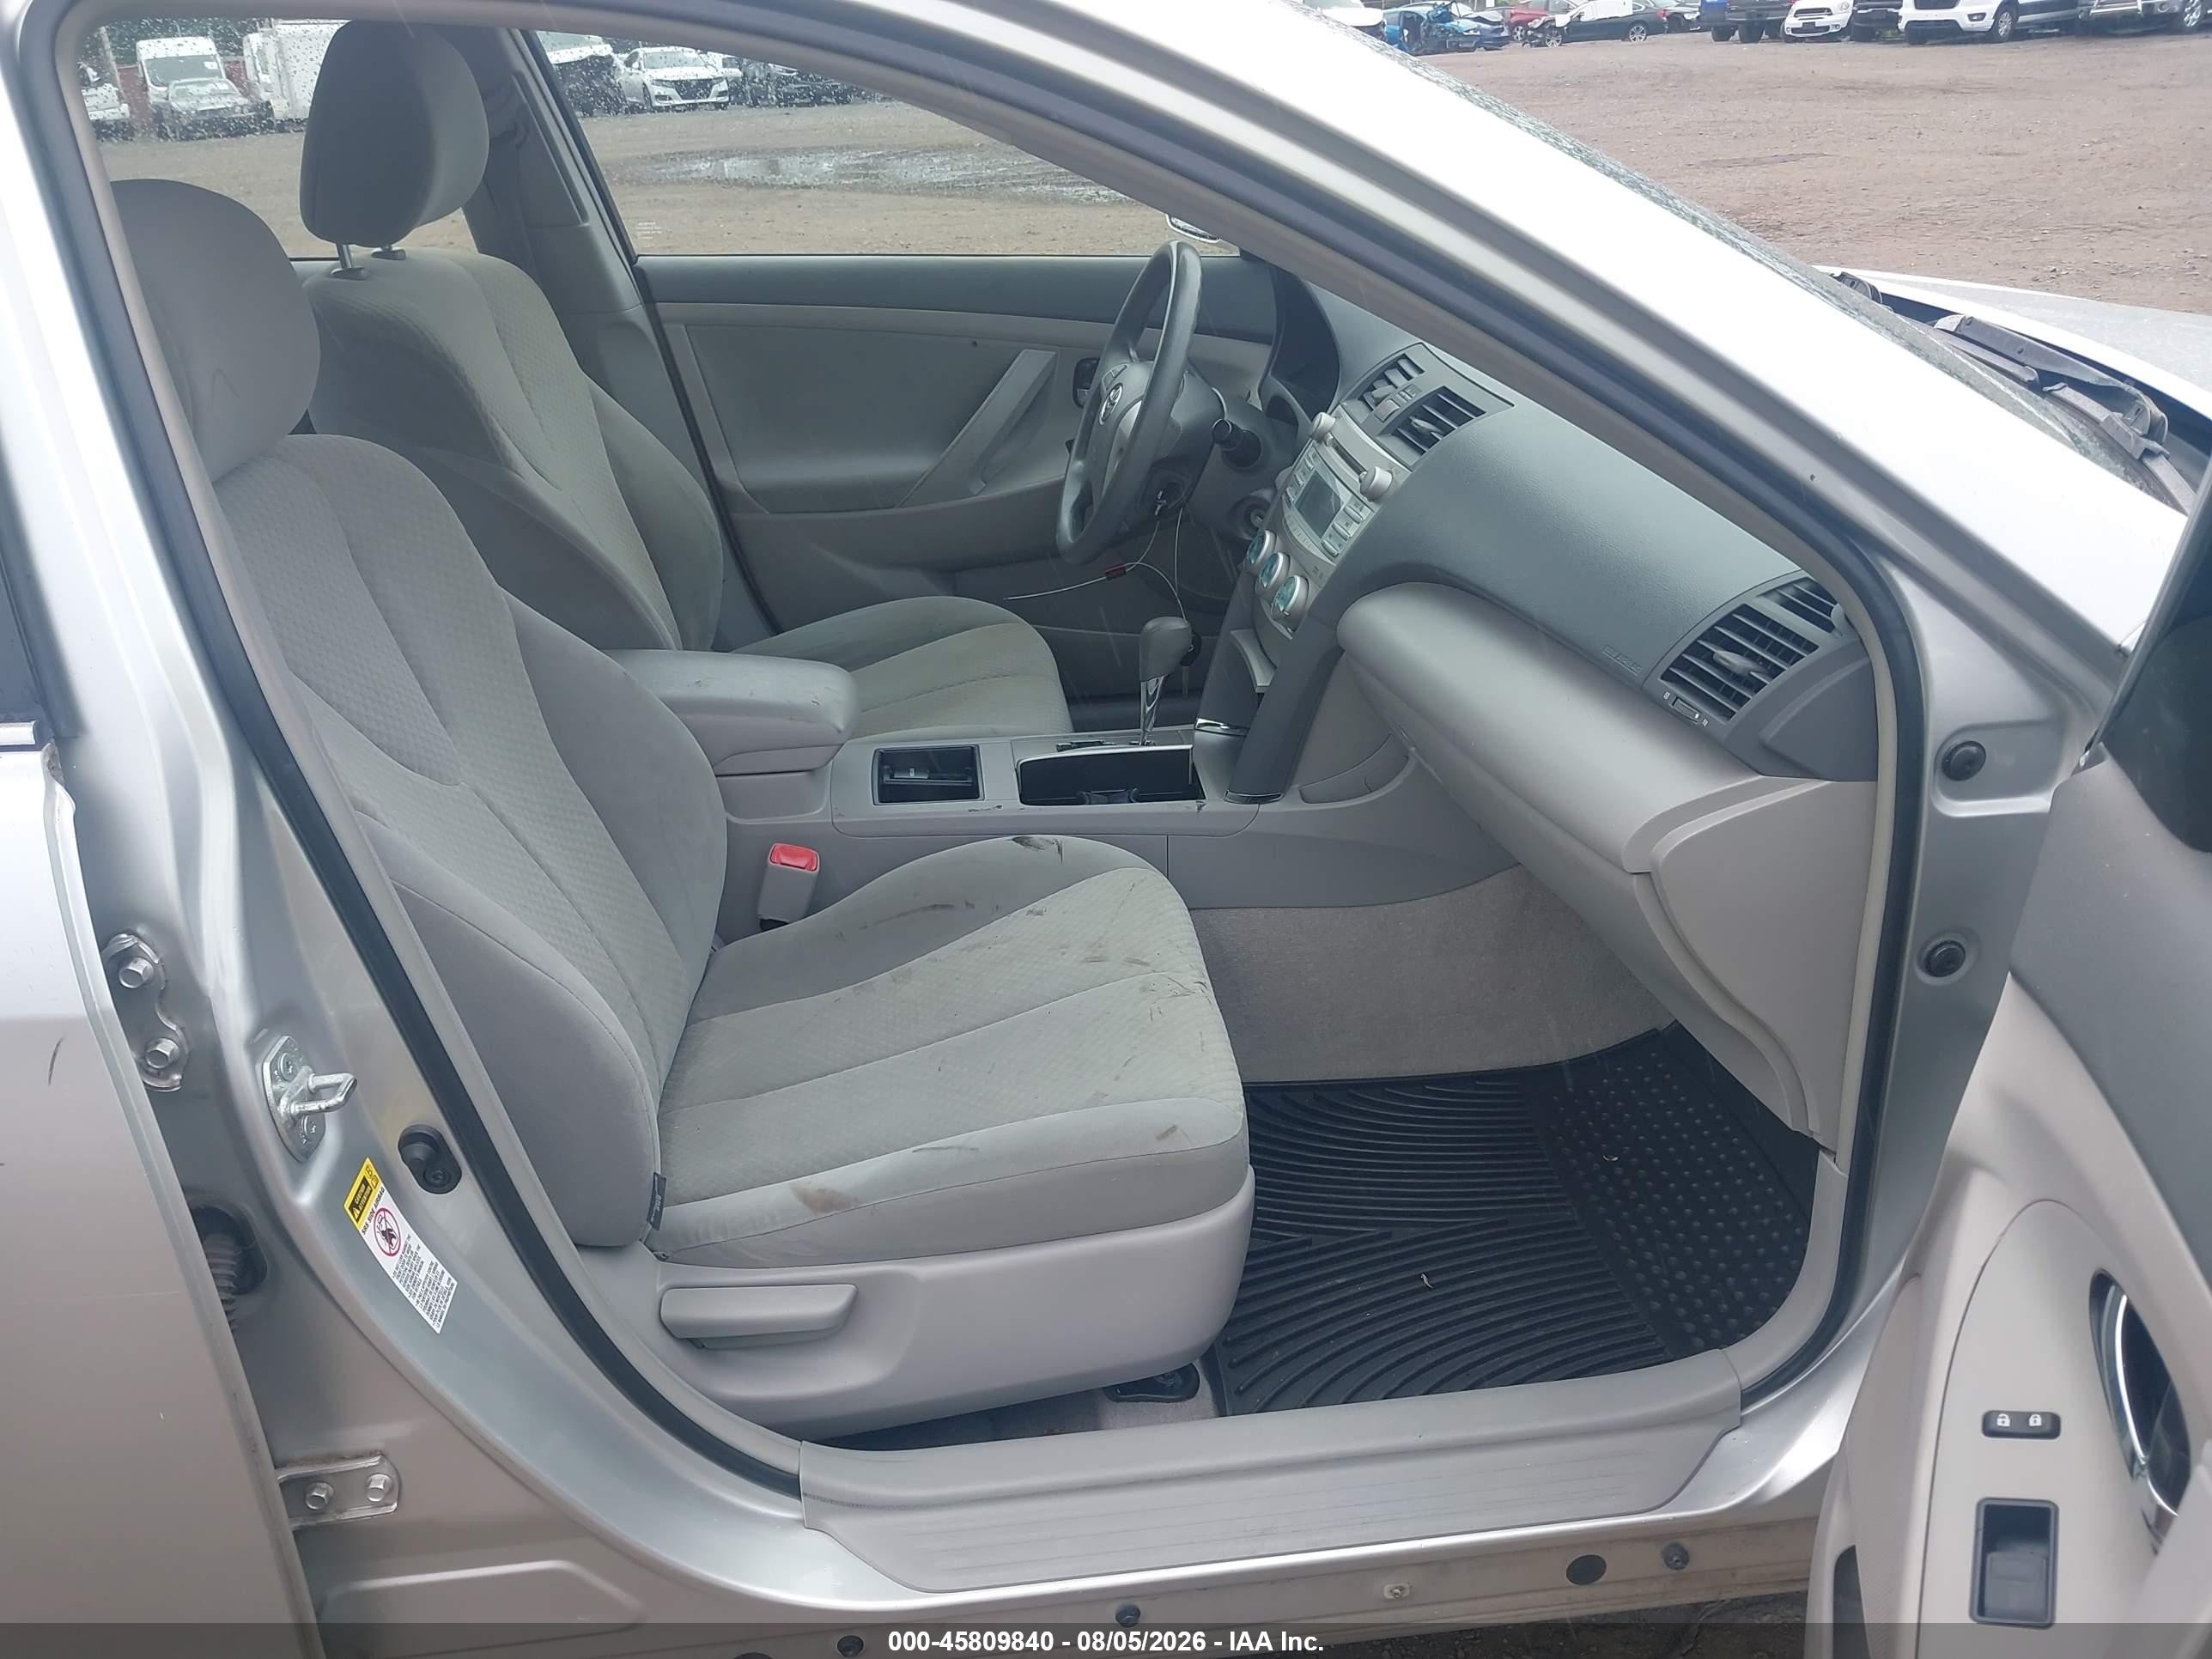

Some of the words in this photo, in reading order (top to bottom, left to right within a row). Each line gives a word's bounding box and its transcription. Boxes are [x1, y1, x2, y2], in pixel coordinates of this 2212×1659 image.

[354, 1183, 366, 1204] CAUTION
[358, 1186, 372, 1212] ATTENTION
[374, 1187, 385, 1209] AIRBAG
